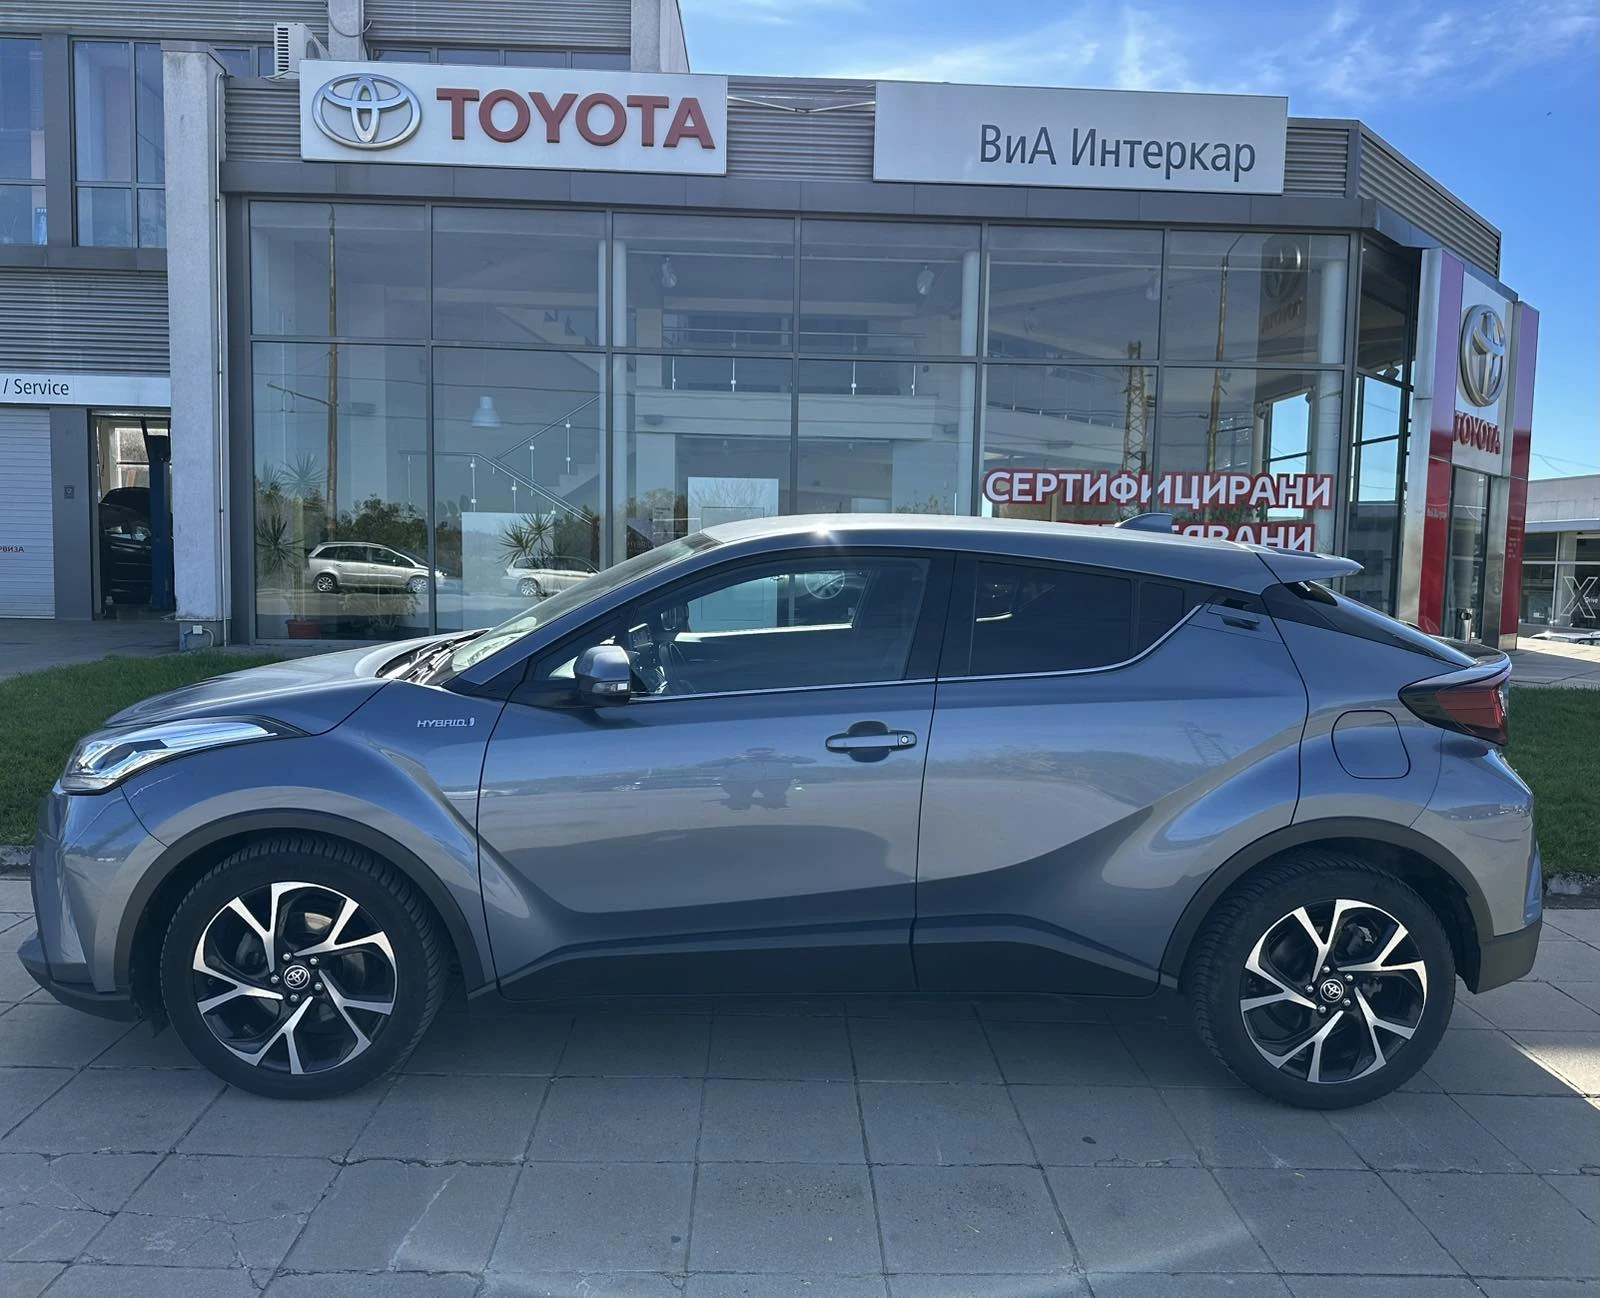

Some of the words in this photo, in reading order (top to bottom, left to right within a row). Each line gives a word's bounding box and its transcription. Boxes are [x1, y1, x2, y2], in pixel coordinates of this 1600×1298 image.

[436, 87, 716, 150] TOYOTA
[979, 123, 1057, 166] ВиА
[1071, 127, 1256, 183] Интеркар
[14, 377, 70, 396] Service
[1453, 412, 1501, 455] TOYOTA
[985, 471, 1331, 510] СЕРТИФИЦИРАНИ
[417, 718, 468, 728] HYBRID
